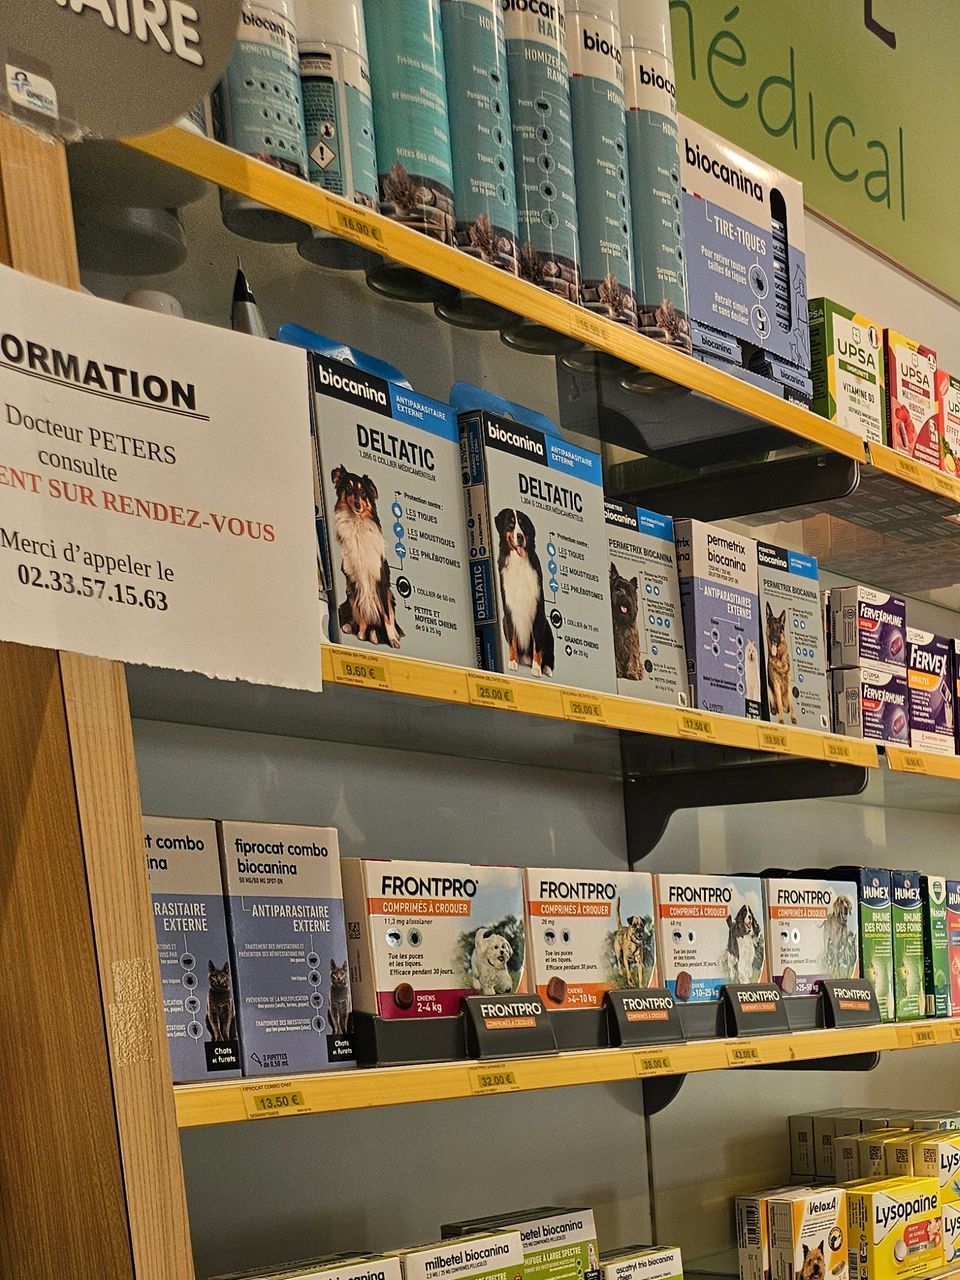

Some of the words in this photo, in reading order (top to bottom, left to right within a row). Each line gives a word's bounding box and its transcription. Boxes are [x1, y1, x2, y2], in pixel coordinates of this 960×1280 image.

[685, 139, 764, 203] biocanina
[714, 216, 766, 256] TIRE-TIQUES
[701, 334, 733, 356] biocanina
[837, 338, 876, 370] UPSA
[0, 333, 196, 410] ORMATION
[900, 363, 930, 388] UPSA
[319, 364, 387, 406] biocanina
[842, 381, 867, 400] VITAMINE
[396, 395, 446, 421] ANTIPARASITAIRE
[397, 404, 424, 420] EXTERNE
[6, 404, 83, 443] Docteur
[90, 426, 177, 465] PETERS
[488, 421, 544, 456] biocanina
[357, 424, 435, 471] DELTATIC
[38, 448, 117, 482] consulte
[518, 473, 583, 513] DELTATIC
[49, 479, 98, 508] SUR
[102, 490, 275, 542] RENDEZ-VOUS
[406, 508, 416, 518] LES
[417, 511, 437, 524] TIQUES
[408, 528, 418, 538] LES
[419, 531, 455, 548] MOUSTIQUES
[707, 534, 745, 555] permetrix
[0, 529, 57, 560] Merci
[157, 563, 174, 583] le
[409, 548, 419, 558] LES
[608, 538, 642, 555] PERMETRIX
[643, 548, 673, 564] BIOCANINA
[707, 548, 746, 572] biocanina
[18, 564, 169, 612] 02.33.57.15.63
[704, 585, 751, 608] ANTIPARASITAIRES
[727, 603, 751, 620] EXTERNES
[910, 643, 947, 676] FERVEX
[345, 664, 365, 678] 9.60
[479, 686, 501, 699] 25.00
[156, 835, 204, 851] combo
[234, 838, 284, 856] fiprocat
[287, 844, 328, 857] combo
[237, 859, 297, 875] biocanina
[382, 876, 477, 898] FRONTPRO
[540, 881, 616, 900] FRONTPRO
[668, 886, 731, 903] FRONTPRO
[863, 886, 889, 900] HUMEX
[895, 888, 920, 901] HUMEX
[383, 900, 427, 913] COMPRIMÉS
[435, 903, 468, 913] CROQUER
[777, 889, 832, 905] FRONTPRO
[252, 904, 329, 918] ANTIPARASITAIRE
[872, 912, 890, 922] RHUME
[164, 919, 208, 932] EXTERNE
[293, 920, 330, 932] EXTERNE
[409, 953, 423, 961] puces
[412, 968, 432, 977] pendant
[417, 1002, 430, 1013] 2-4
[431, 1002, 442, 1013] kg
[588, 993, 597, 1004] kg
[480, 1003, 542, 1017] FRONTPRO
[481, 1075, 504, 1087] 32.00
[259, 1096, 289, 1109] 13.50
[875, 1195, 938, 1228] Lysopaïne
[648, 1254, 674, 1266] biocanina
